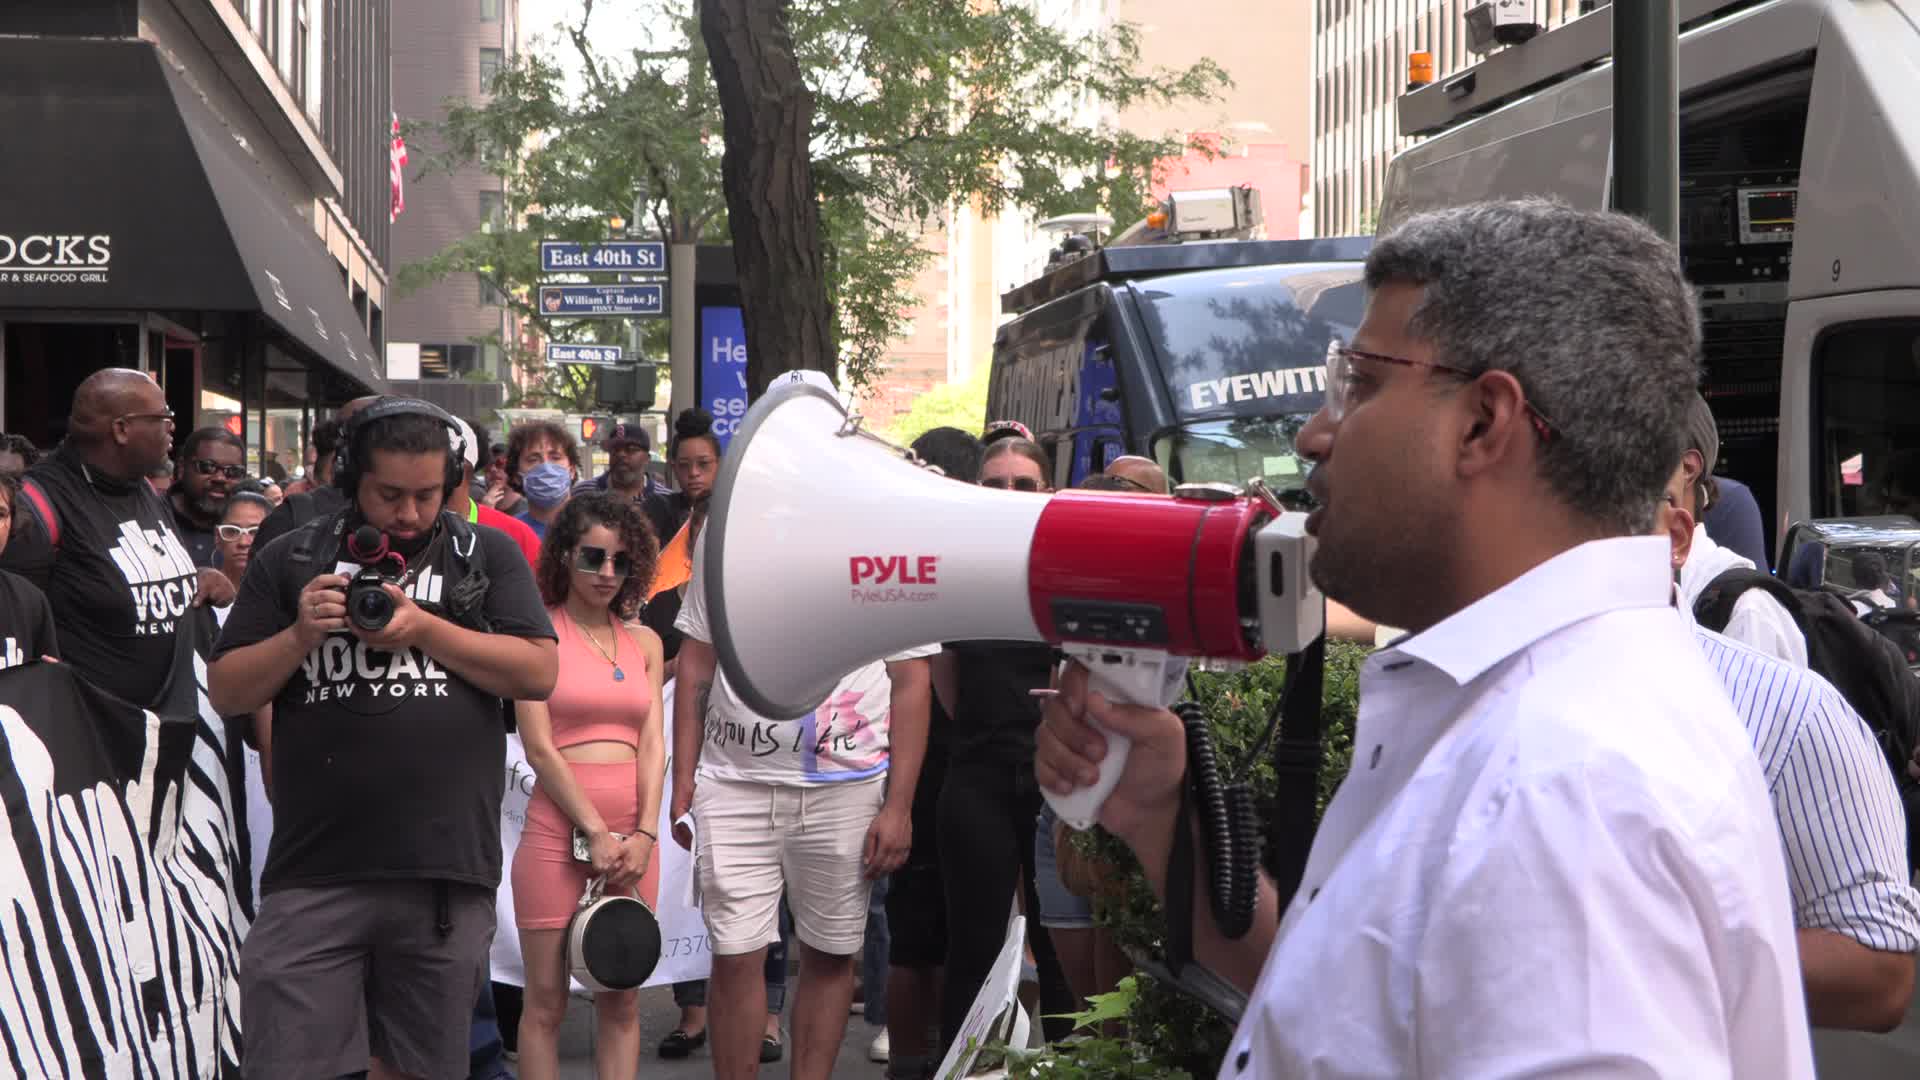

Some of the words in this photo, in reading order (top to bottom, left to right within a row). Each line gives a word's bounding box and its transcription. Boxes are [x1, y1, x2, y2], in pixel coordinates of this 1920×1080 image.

[550, 249, 588, 265] East
[593, 249, 632, 265] 40th
[637, 248, 656, 265] St
[12, 273, 20, 283] &
[23, 273, 77, 283] SEAFOOD
[80, 273, 108, 283] GRILL
[1831, 258, 1841, 283] 9
[564, 294, 603, 305] William
[605, 294, 615, 304] F.
[616, 293, 645, 304] Burke
[552, 347, 576, 360] East
[577, 349, 602, 361] 40th
[604, 350, 617, 361] St
[849, 555, 937, 585] PYLE
[135, 621, 174, 635] NEW
[304, 683, 356, 705] NEW
[368, 682, 449, 698] YORK
